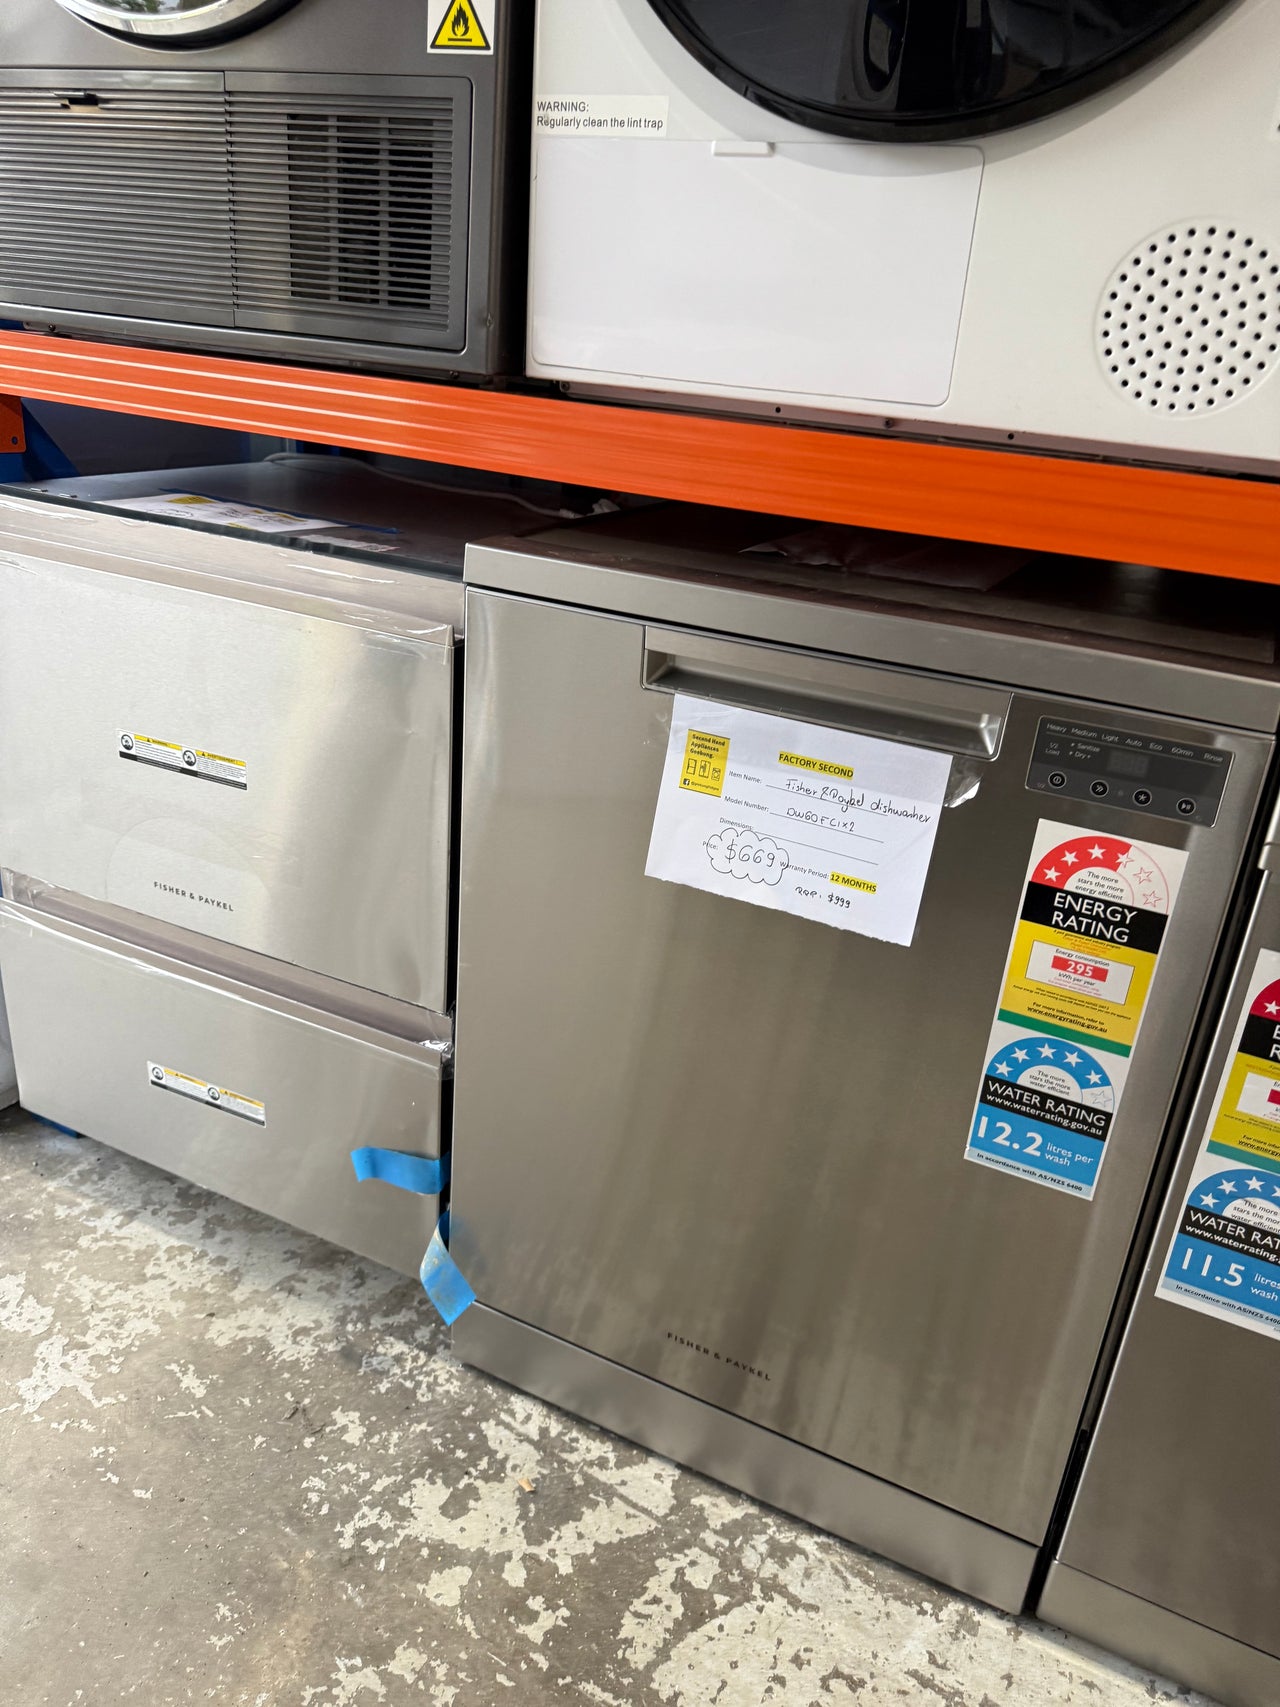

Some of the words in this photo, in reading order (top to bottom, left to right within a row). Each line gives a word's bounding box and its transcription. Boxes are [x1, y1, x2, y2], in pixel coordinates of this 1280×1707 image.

[537, 101, 589, 112] WARNING:
[536, 115, 581, 129] Regularly
[583, 117, 608, 127] clean
[610, 117, 625, 128] the
[627, 117, 642, 128] lint
[643, 118, 663, 130] trap
[1047, 723, 1067, 733] Heavy
[1071, 728, 1097, 738] Medium
[1101, 733, 1119, 742] Light
[1125, 738, 1142, 747] Auto
[1149, 742, 1163, 751] Eco
[1203, 753, 1223, 762] Rinse
[779, 753, 817, 769] FACTORY
[818, 763, 854, 778] SECOND
[729, 770, 742, 780] Item
[743, 774, 762, 784] Name:
[786, 779, 817, 795] Fisher
[724, 796, 743, 806] Model
[744, 801, 769, 812] Number:
[724, 838, 776, 868] $669
[808, 868, 829, 879] Period:
[830, 874, 840, 882] 12
[842, 877, 877, 892] MONTHS
[1088, 871, 1100, 879] The
[154, 881, 186, 898] FISHER
[189, 892, 195, 900] &
[199, 895, 234, 912] PAYKEL
[1075, 885, 1096, 895] energy
[1098, 891, 1122, 900] efficient
[1107, 885, 1124, 893] more
[828, 892, 851, 908] $999
[1053, 892, 1138, 925] ENERGY
[1051, 910, 1130, 943] RATING
[1055, 948, 1074, 958] Energy
[1075, 954, 1110, 967] consumption
[1066, 960, 1094, 977] 295
[1027, 1006, 1107, 1034] www.energyrating.gov.au
[1030, 1074, 1042, 1082] stars
[1030, 1080, 1046, 1088] water
[1038, 1070, 1048, 1078] The
[1050, 1075, 1065, 1083] more
[988, 1080, 1040, 1107] WATER
[1045, 1098, 1106, 1127] RATING
[986, 1094, 1103, 1136] www.waterrating.gov.au
[978, 1115, 1043, 1157] 12.2
[1046, 1142, 1073, 1158] litres
[1075, 1153, 1094, 1165] per
[1045, 1152, 1070, 1167] wash
[985, 1156, 1020, 1171] accordance
[1022, 1168, 1037, 1176] with
[1066, 1182, 1082, 1192] 6400
[1233, 1206, 1250, 1215] stars
[1244, 1199, 1257, 1209] The
[1259, 1206, 1278, 1216] more
[1190, 1210, 1246, 1239] WATER
[1231, 1214, 1251, 1224] water
[1181, 1248, 1246, 1287] 11.5
[1184, 1288, 1220, 1304] accordance
[1222, 1300, 1236, 1310] with
[1250, 1286, 1278, 1302] wash
[667, 1332, 709, 1355] FISHER
[714, 1352, 720, 1360] &
[726, 1358, 771, 1381] PAYKEL
